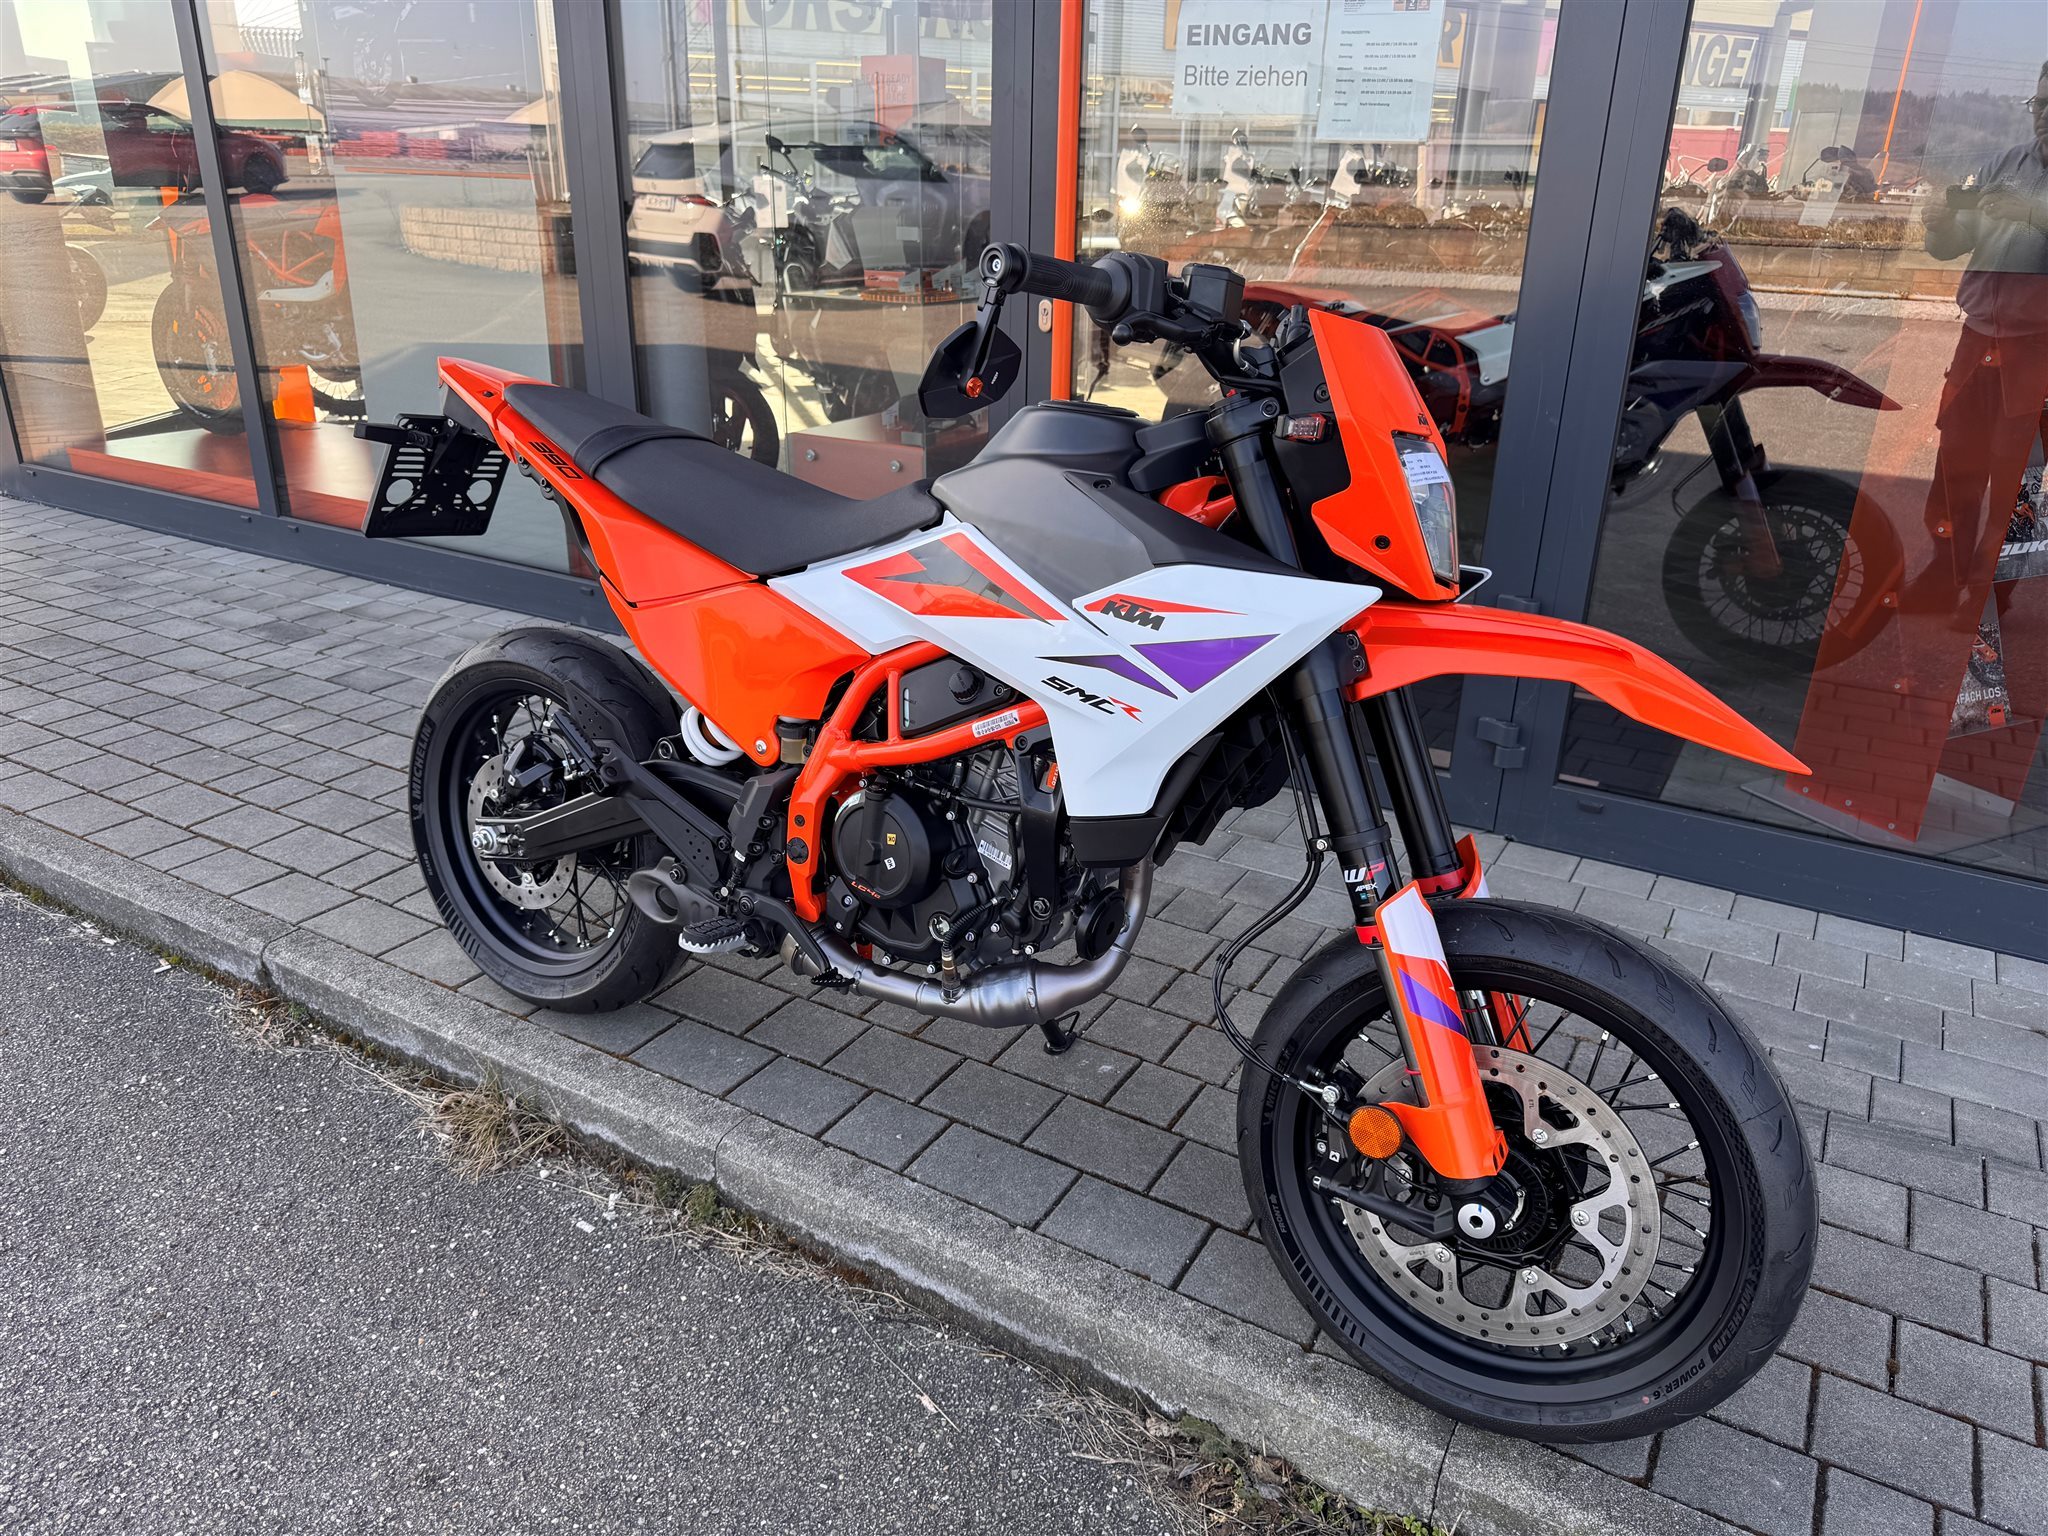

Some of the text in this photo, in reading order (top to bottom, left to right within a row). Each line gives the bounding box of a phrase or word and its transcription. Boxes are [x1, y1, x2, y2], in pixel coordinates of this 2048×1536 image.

[1186, 23, 1312, 46] EINGANG
[1184, 64, 1308, 87] Bitte ziehen
[528, 441, 584, 480] 390
[1100, 598, 1166, 631] KTM
[1983, 687, 2001, 700] LOS
[411, 723, 433, 800] MICHELIN
[886, 859, 894, 868] OK
[1344, 862, 1385, 883] WP
[1355, 882, 1378, 892] APEX
[1272, 1202, 1287, 1234] FRONT
[1712, 1284, 1757, 1357] MICHELIN
[1664, 1357, 1706, 1396] POWER
[1652, 1390, 1661, 1401] 6
